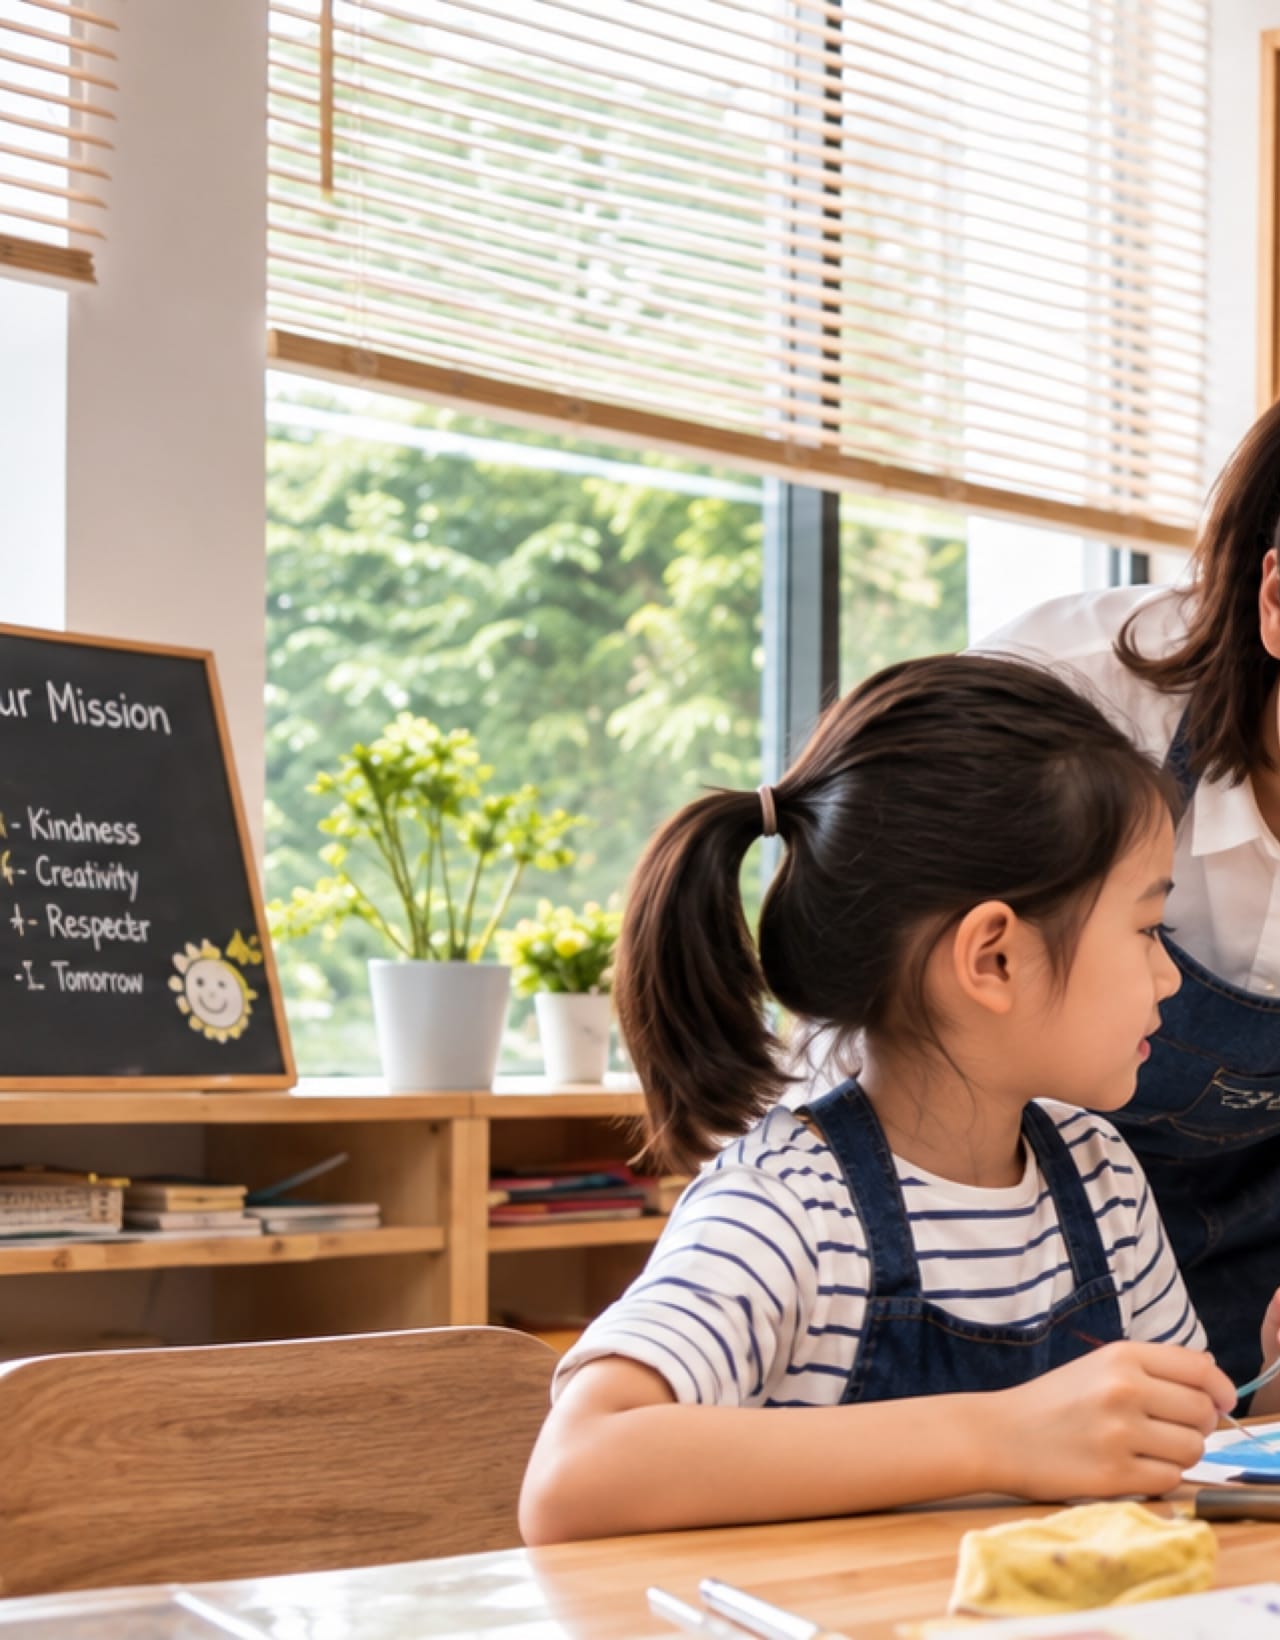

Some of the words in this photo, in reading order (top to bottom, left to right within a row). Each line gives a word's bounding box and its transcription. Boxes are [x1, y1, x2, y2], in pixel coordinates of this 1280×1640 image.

[47, 679, 172, 734] Mission
[27, 805, 141, 845] Kindness
[35, 854, 139, 902] Creativity
[50, 960, 144, 993] Tomorrow
